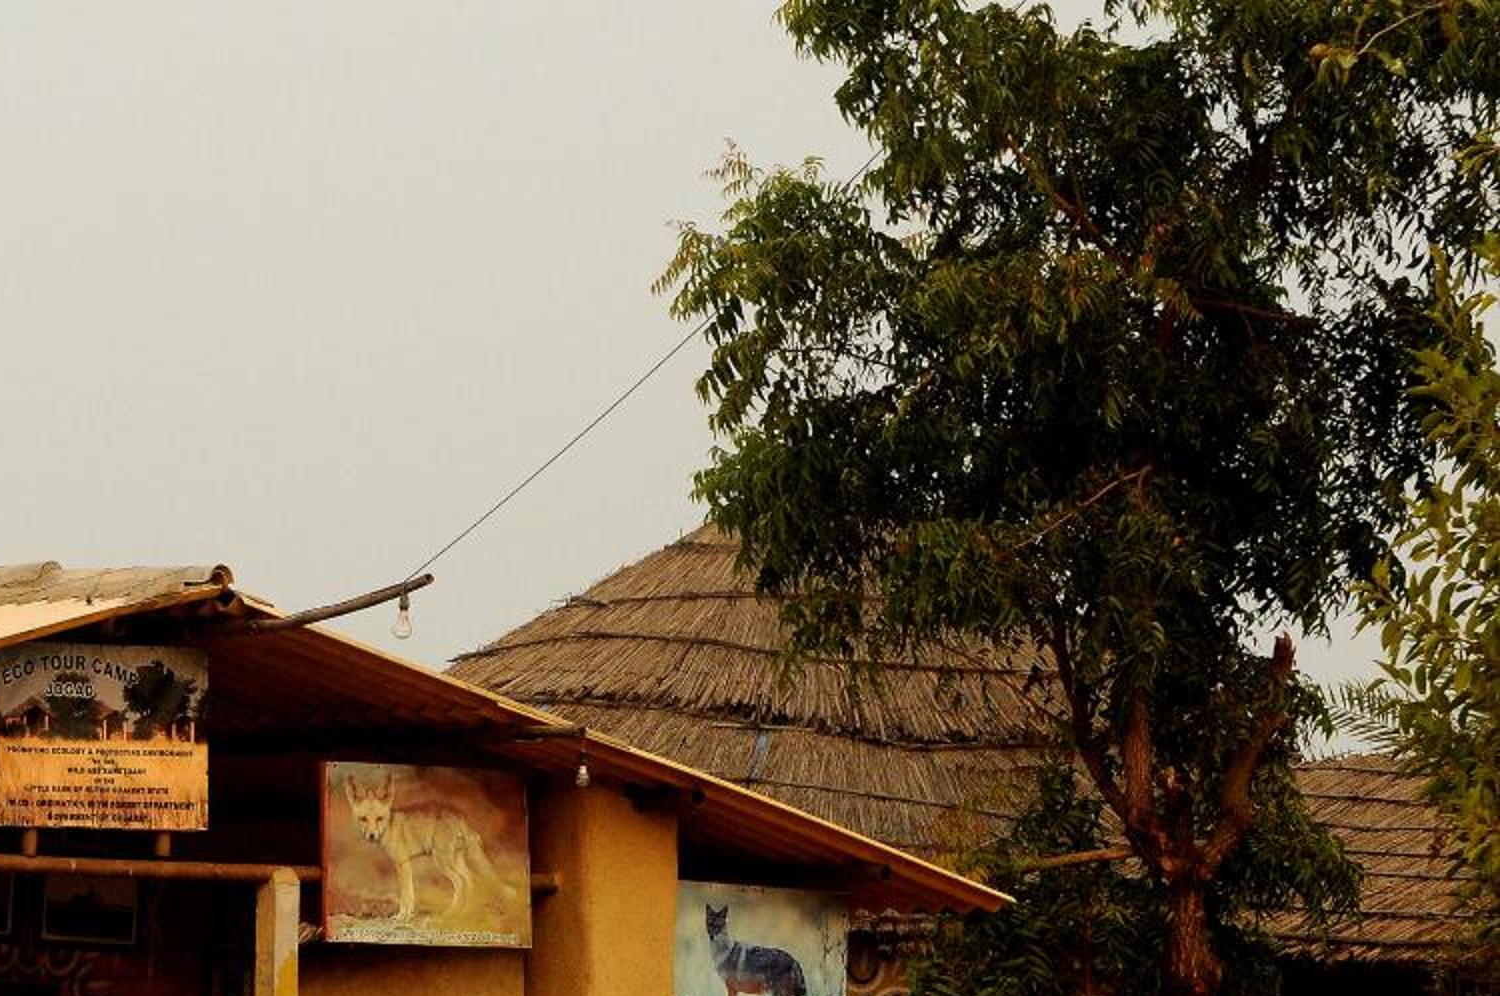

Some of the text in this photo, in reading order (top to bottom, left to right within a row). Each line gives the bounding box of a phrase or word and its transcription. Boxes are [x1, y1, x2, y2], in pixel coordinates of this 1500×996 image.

[2, 655, 139, 685] ECO TOUR CAMP
